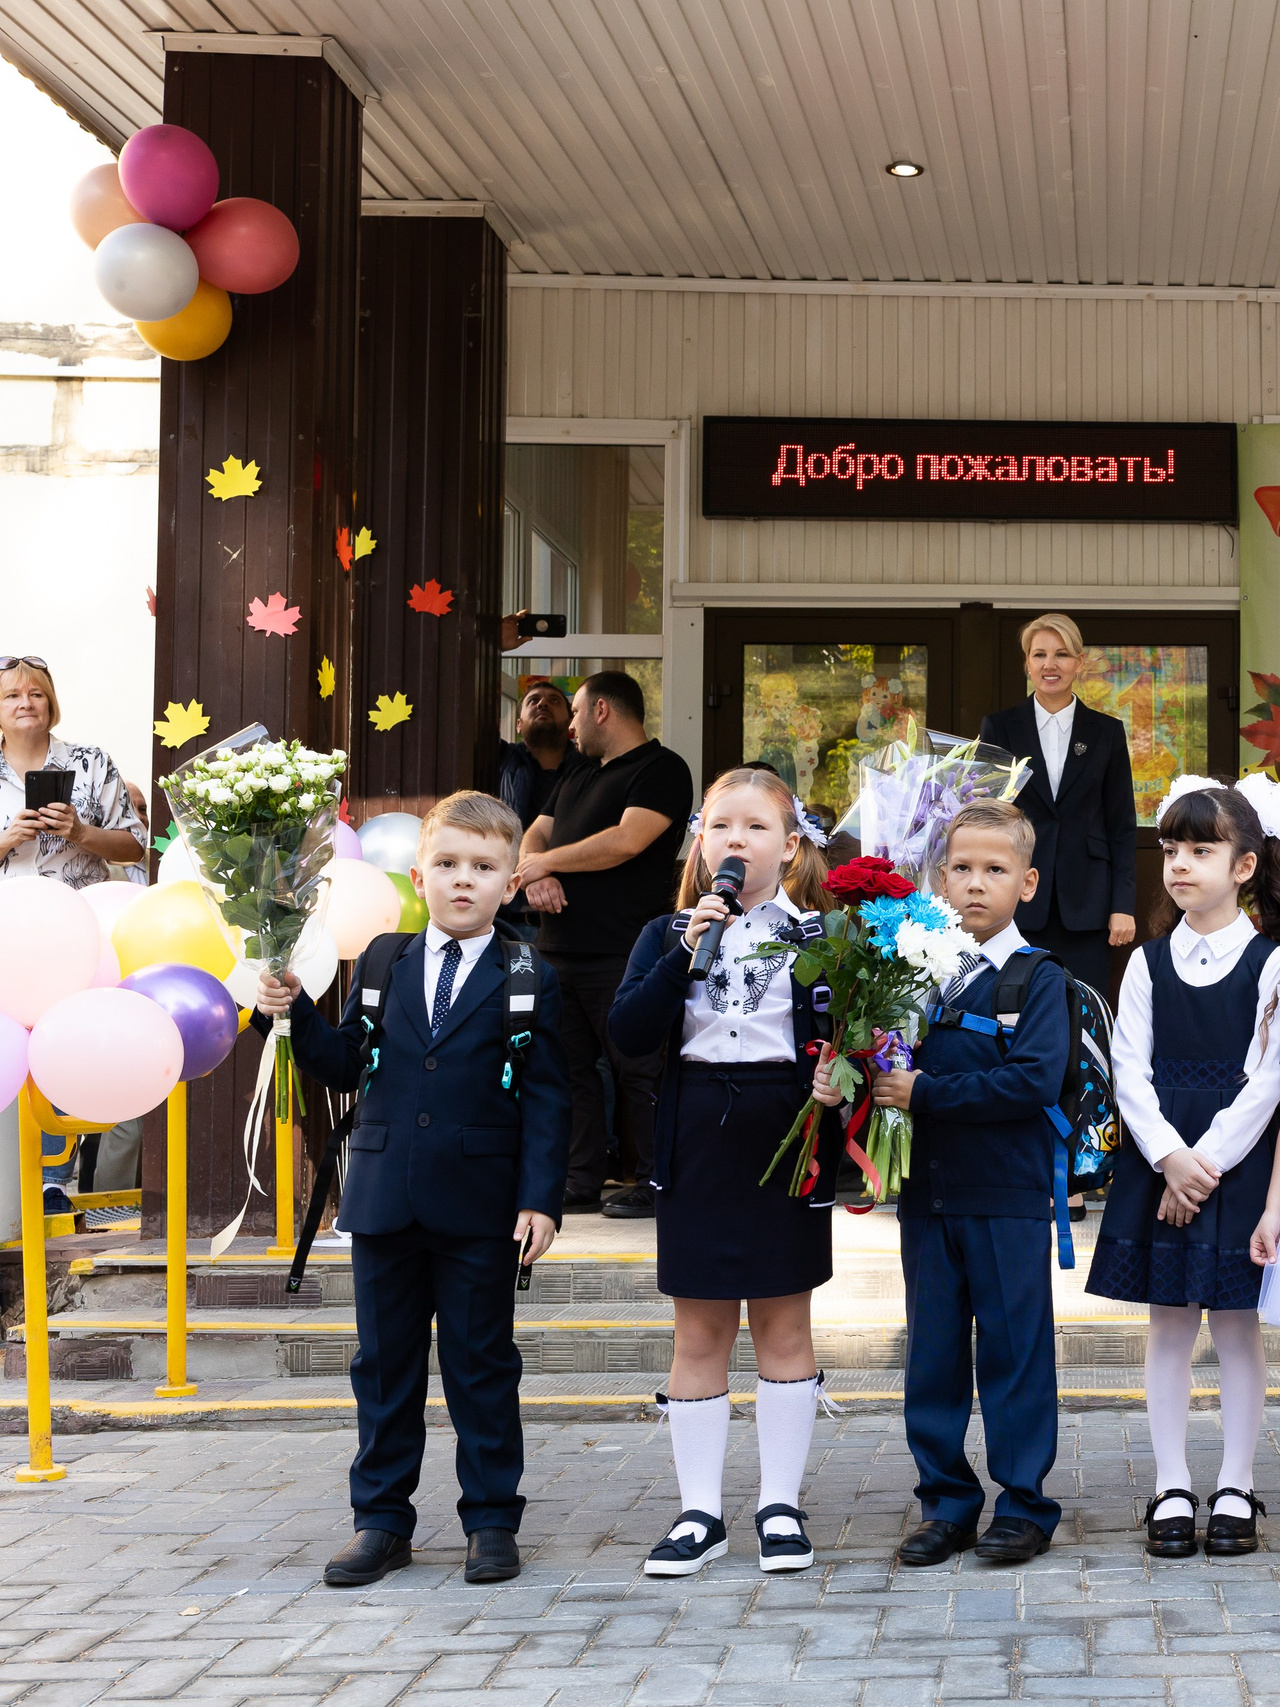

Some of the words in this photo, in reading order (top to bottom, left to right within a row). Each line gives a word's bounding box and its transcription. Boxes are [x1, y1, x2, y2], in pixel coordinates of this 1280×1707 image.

[772, 443, 904, 489] Добро
[916, 449, 1175, 482] пожаловать!
[1116, 672, 1155, 770] 1
